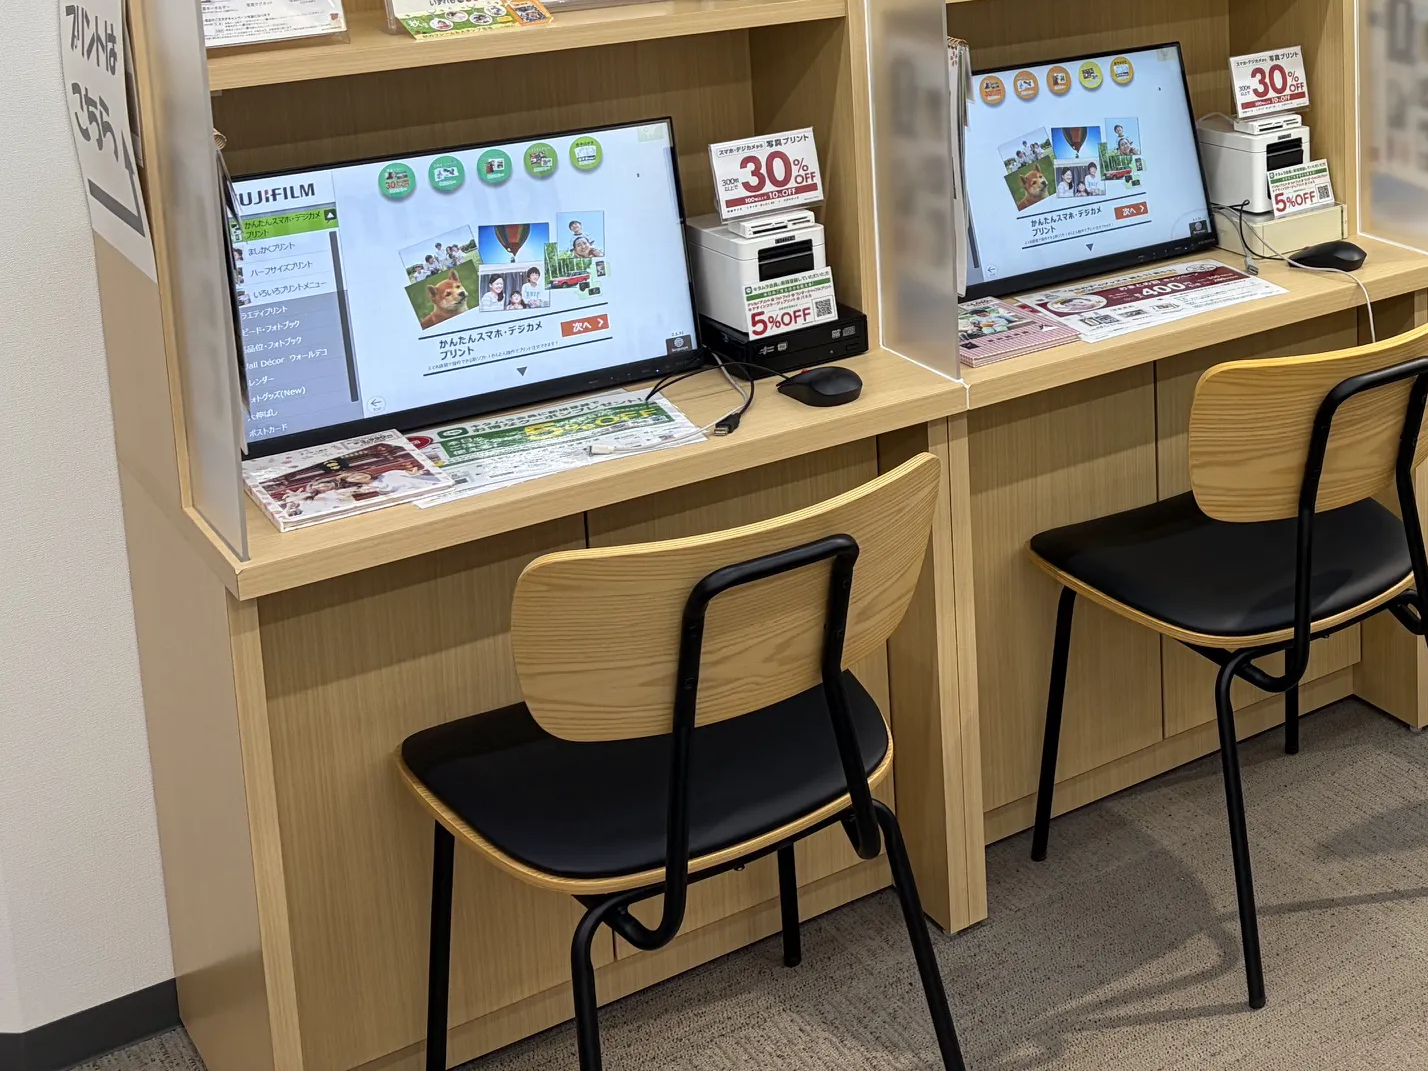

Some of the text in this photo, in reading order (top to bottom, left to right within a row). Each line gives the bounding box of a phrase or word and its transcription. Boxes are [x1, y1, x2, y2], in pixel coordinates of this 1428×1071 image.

[65, 5, 118, 76] プリントは
[1289, 83, 1304, 92] OFF
[71, 82, 119, 161] こちら
[766, 134, 809, 147] 写真プリント
[794, 172, 816, 185] OFF
[236, 182, 316, 207] UJIFILM
[1275, 191, 1316, 212] 5%OFF
[1123, 207, 1136, 216] 次へ
[246, 230, 268, 238] プリント
[1032, 225, 1056, 237] プリント
[248, 242, 295, 256] ましかくプリント
[250, 261, 313, 277] ハーフサイズプリント
[254, 281, 327, 298] いろいろプリントメニュー
[572, 321, 592, 332] 次へ
[751, 307, 811, 335] 5%OFF
[440, 321, 542, 349] かんたんスマホ・デジカメ
[245, 337, 302, 353] 品位・フォトブック
[440, 346, 474, 360] プリント
[250, 424, 287, 437] ポストカード
